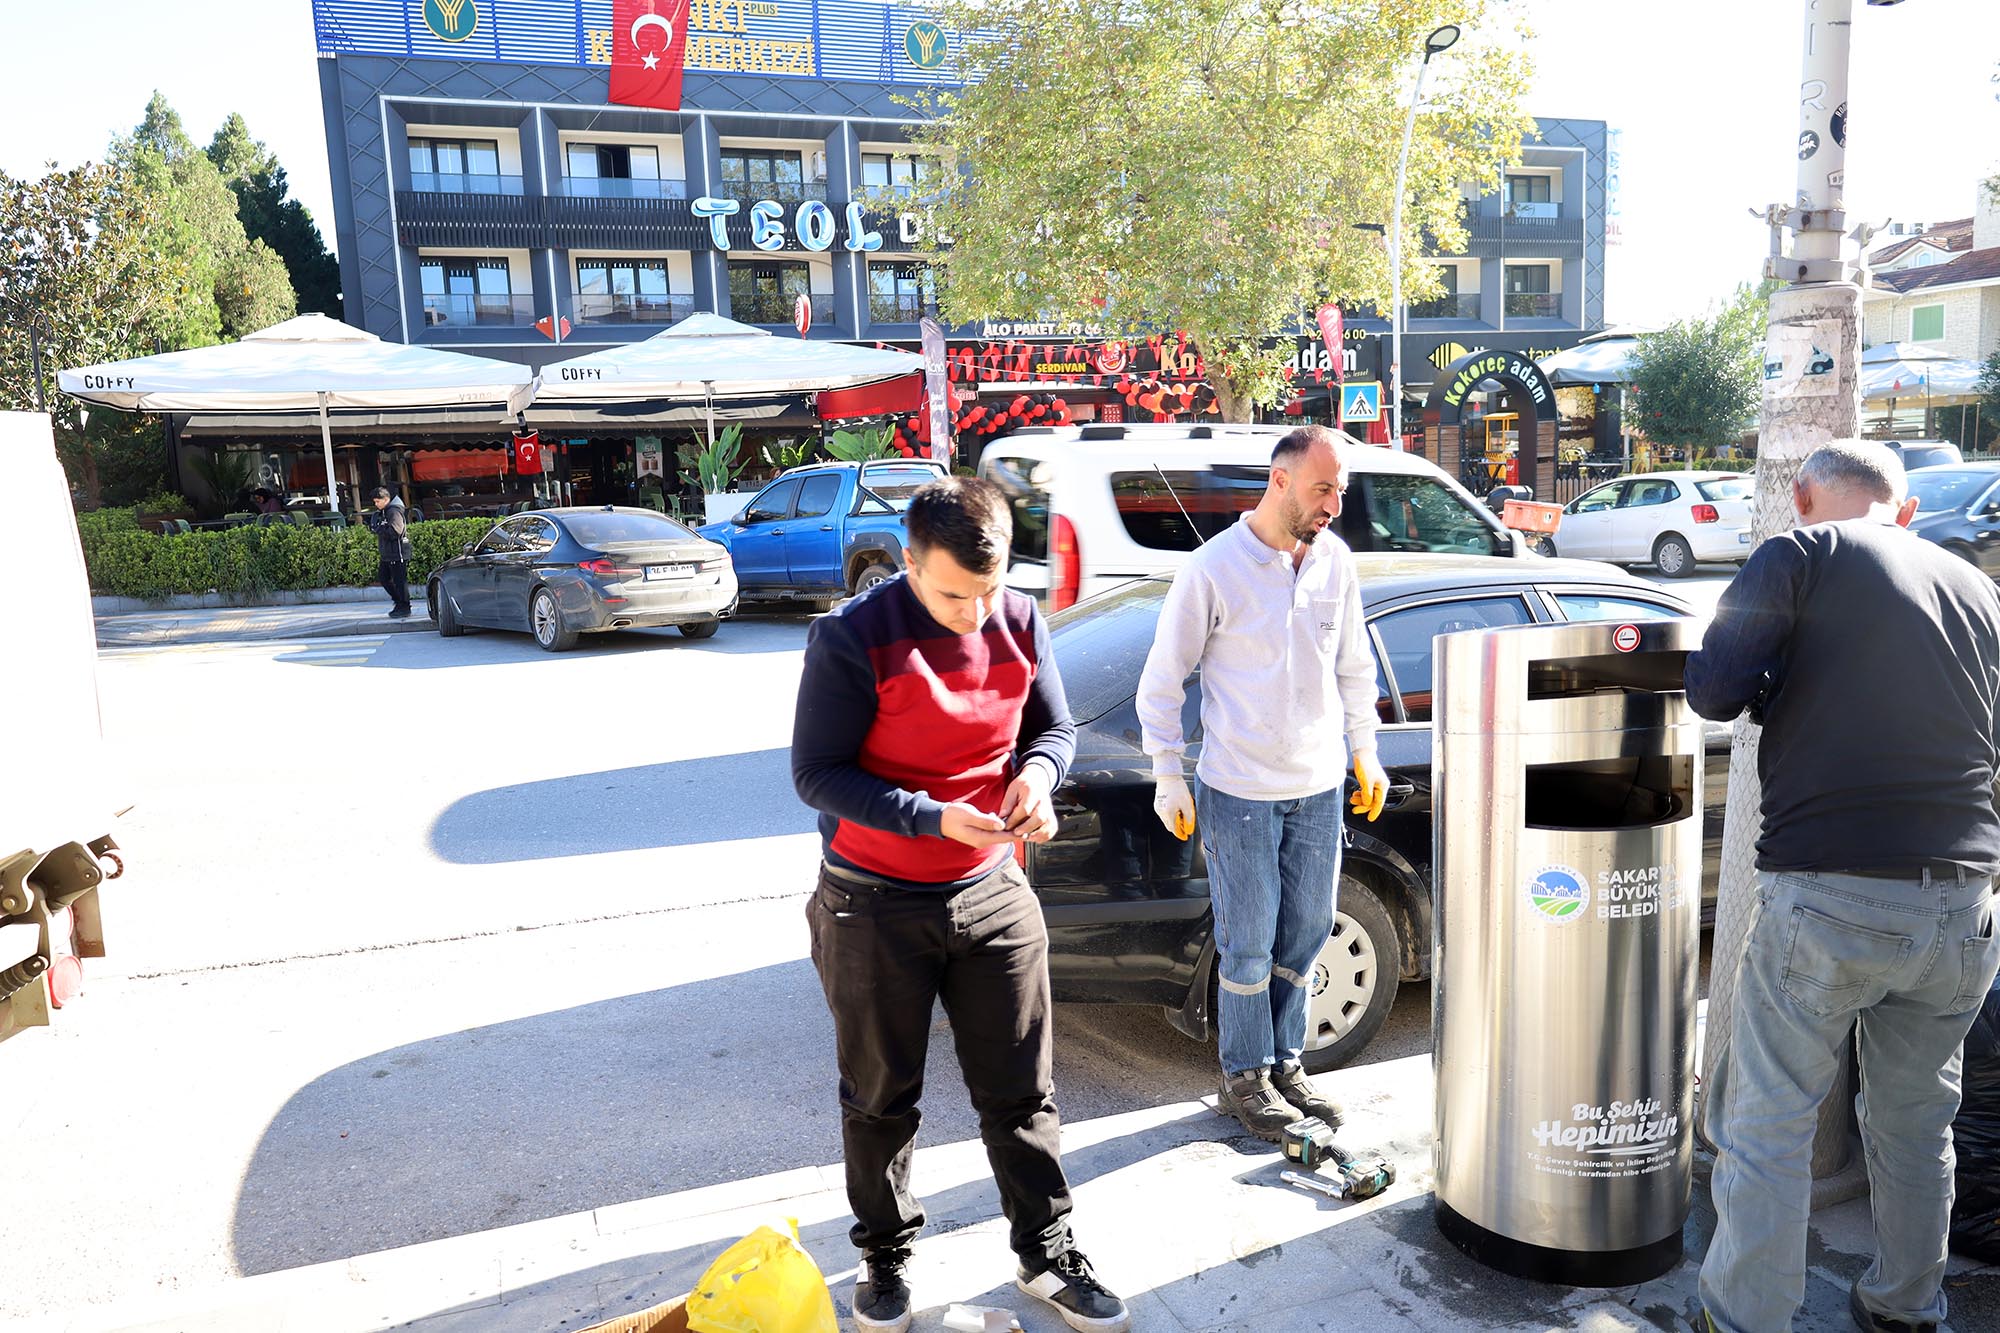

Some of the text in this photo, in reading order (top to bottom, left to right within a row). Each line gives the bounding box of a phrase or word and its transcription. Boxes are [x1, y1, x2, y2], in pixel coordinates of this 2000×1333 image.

[750, 3, 777, 15] PLUS
[685, 34, 816, 74] MERKEZİ
[691, 197, 883, 251] TEOL
[983, 323, 1010, 337] ALO
[1014, 323, 1055, 336] PAKET
[1352, 328, 1366, 340] 00
[84, 374, 134, 389] COFFY
[561, 367, 601, 381] COFFY
[1444, 356, 1546, 407] Kokoreç adam
[1598, 865, 1676, 885] SAKARYA
[1572, 1097, 1661, 1124] Bu Şehir
[1531, 1112, 1678, 1152] Hepimizin
[1545, 1156, 1571, 1166] Çevre
[1573, 1160, 1613, 1168] Şehircilik
[1627, 1158, 1645, 1167] İklim
[1535, 1163, 1576, 1177] Bakanlığı
[1623, 1169, 1640, 1177] hibe
